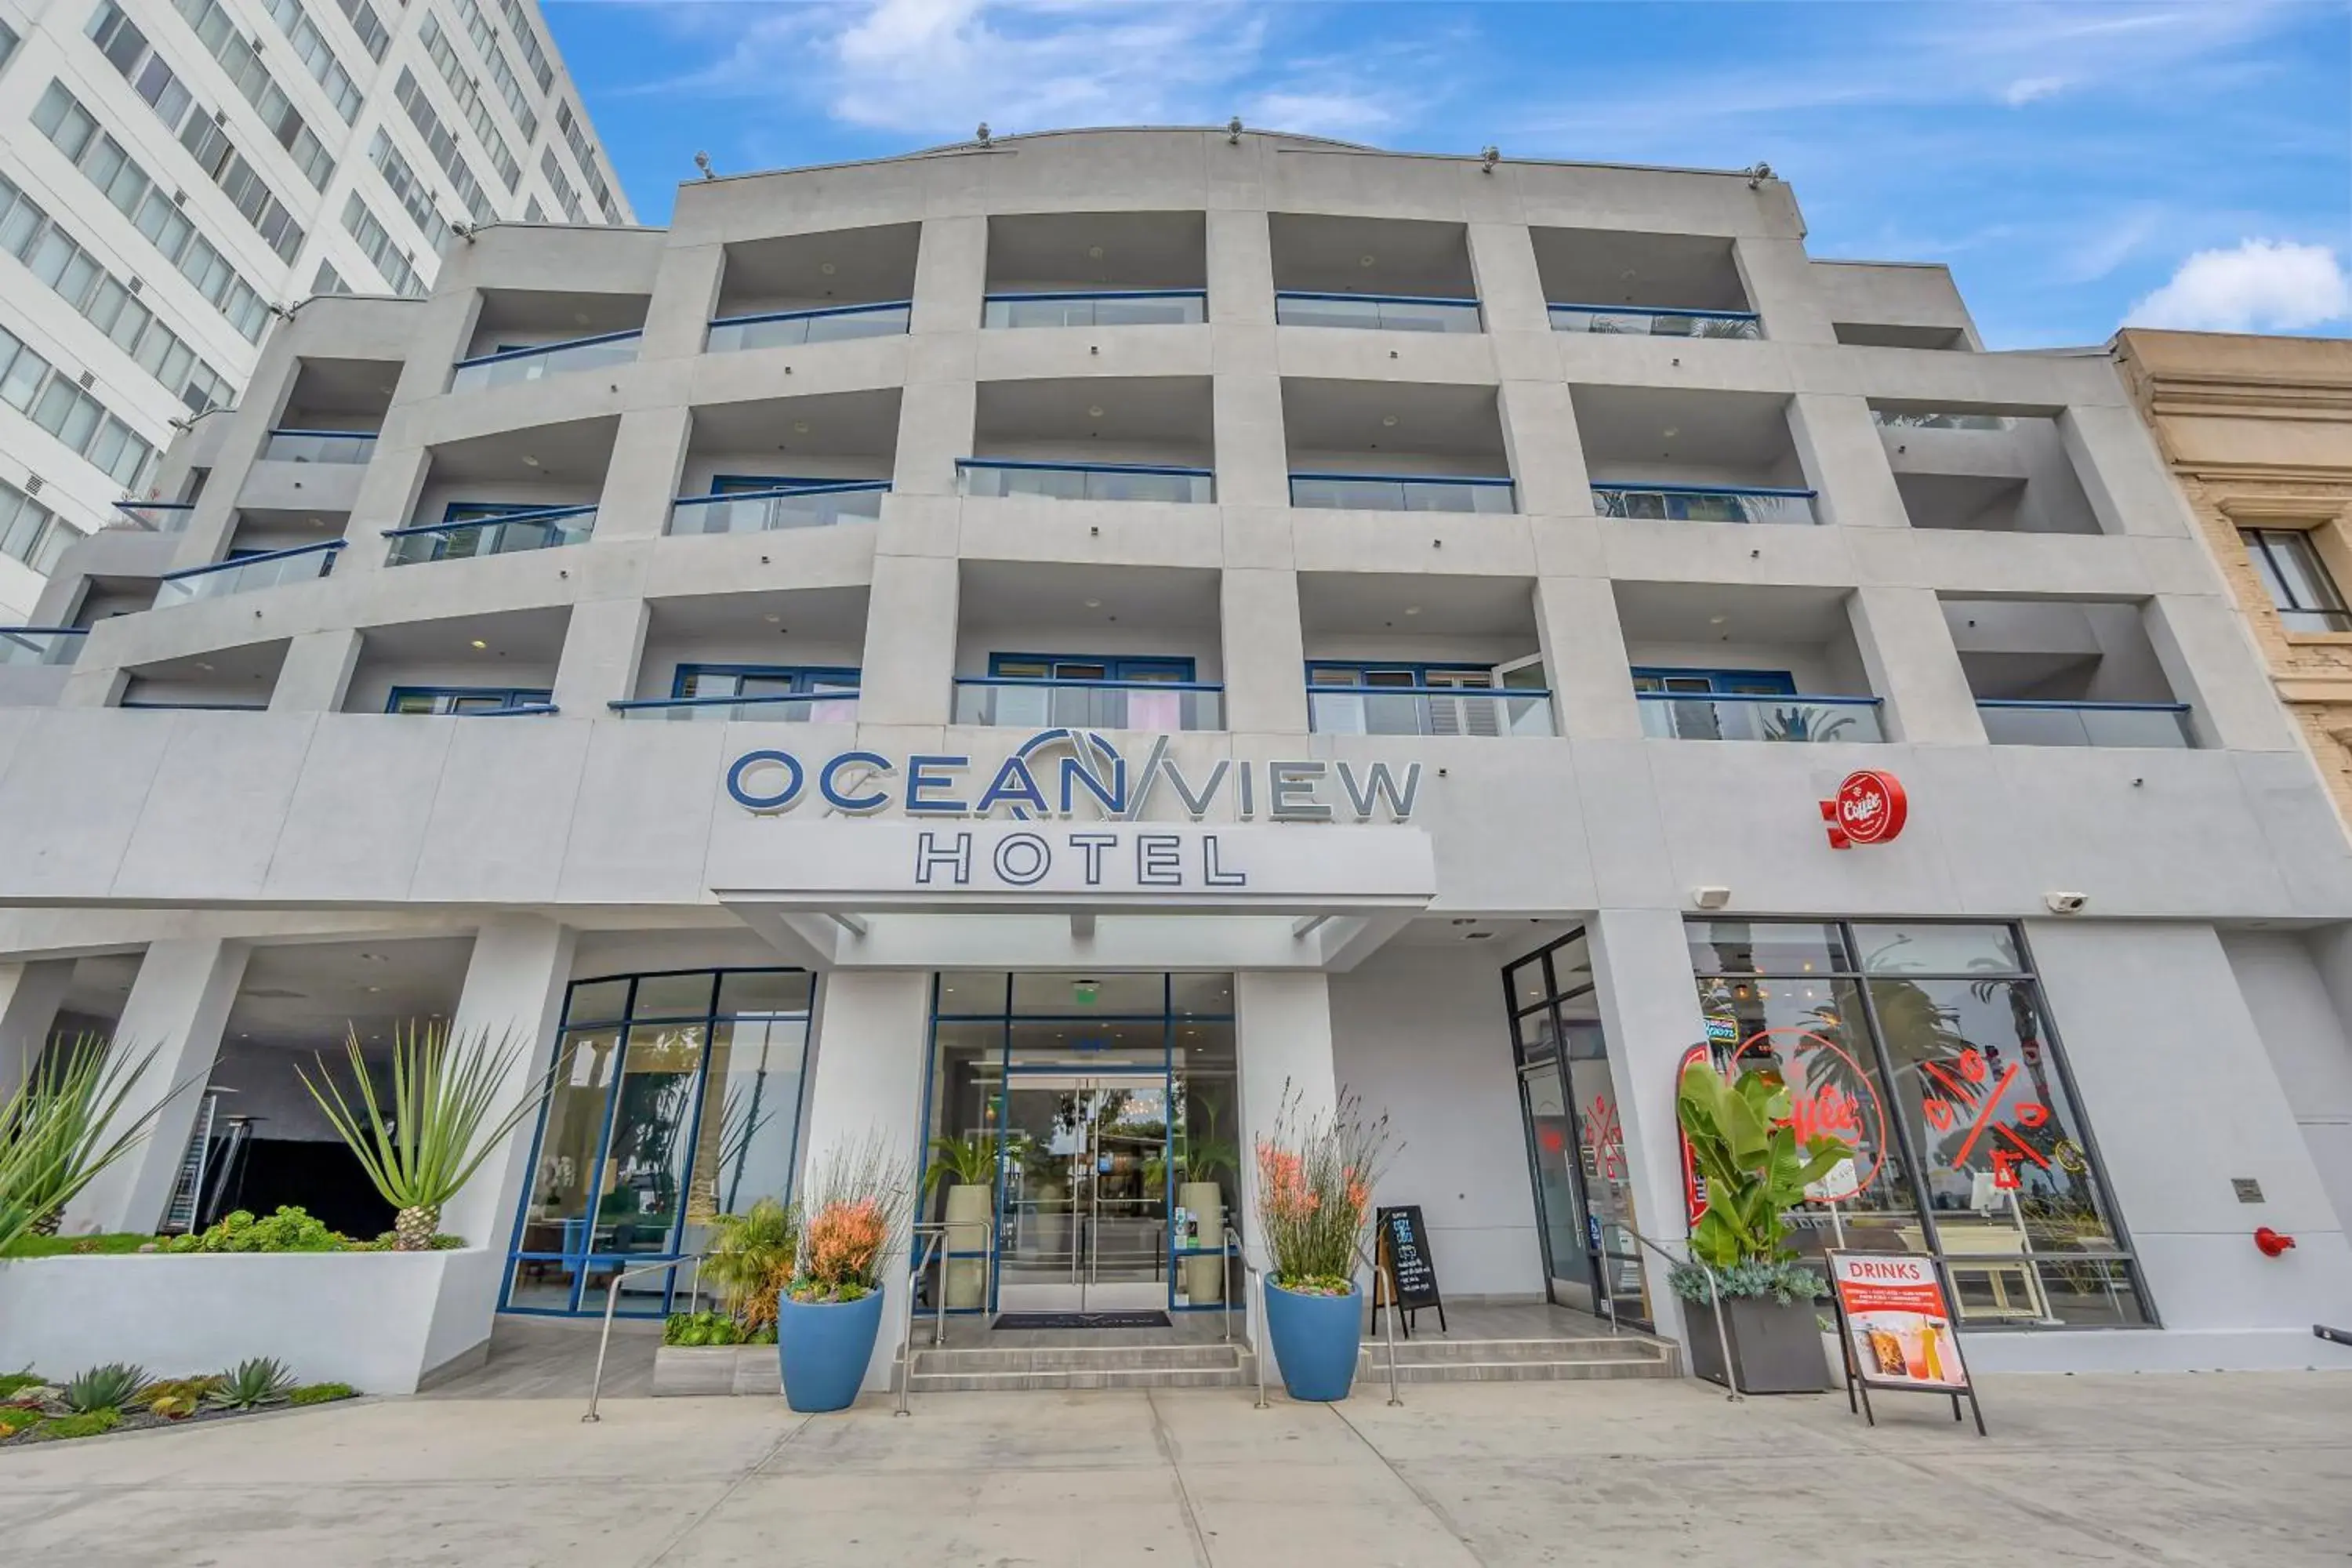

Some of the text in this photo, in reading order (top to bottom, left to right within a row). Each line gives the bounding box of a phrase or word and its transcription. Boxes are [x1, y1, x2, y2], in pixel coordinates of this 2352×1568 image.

[726, 749, 1422, 822] OCEAN VIEW
[915, 832, 1247, 887] HOTEL
[1849, 1261, 1921, 1280] DRINKS
